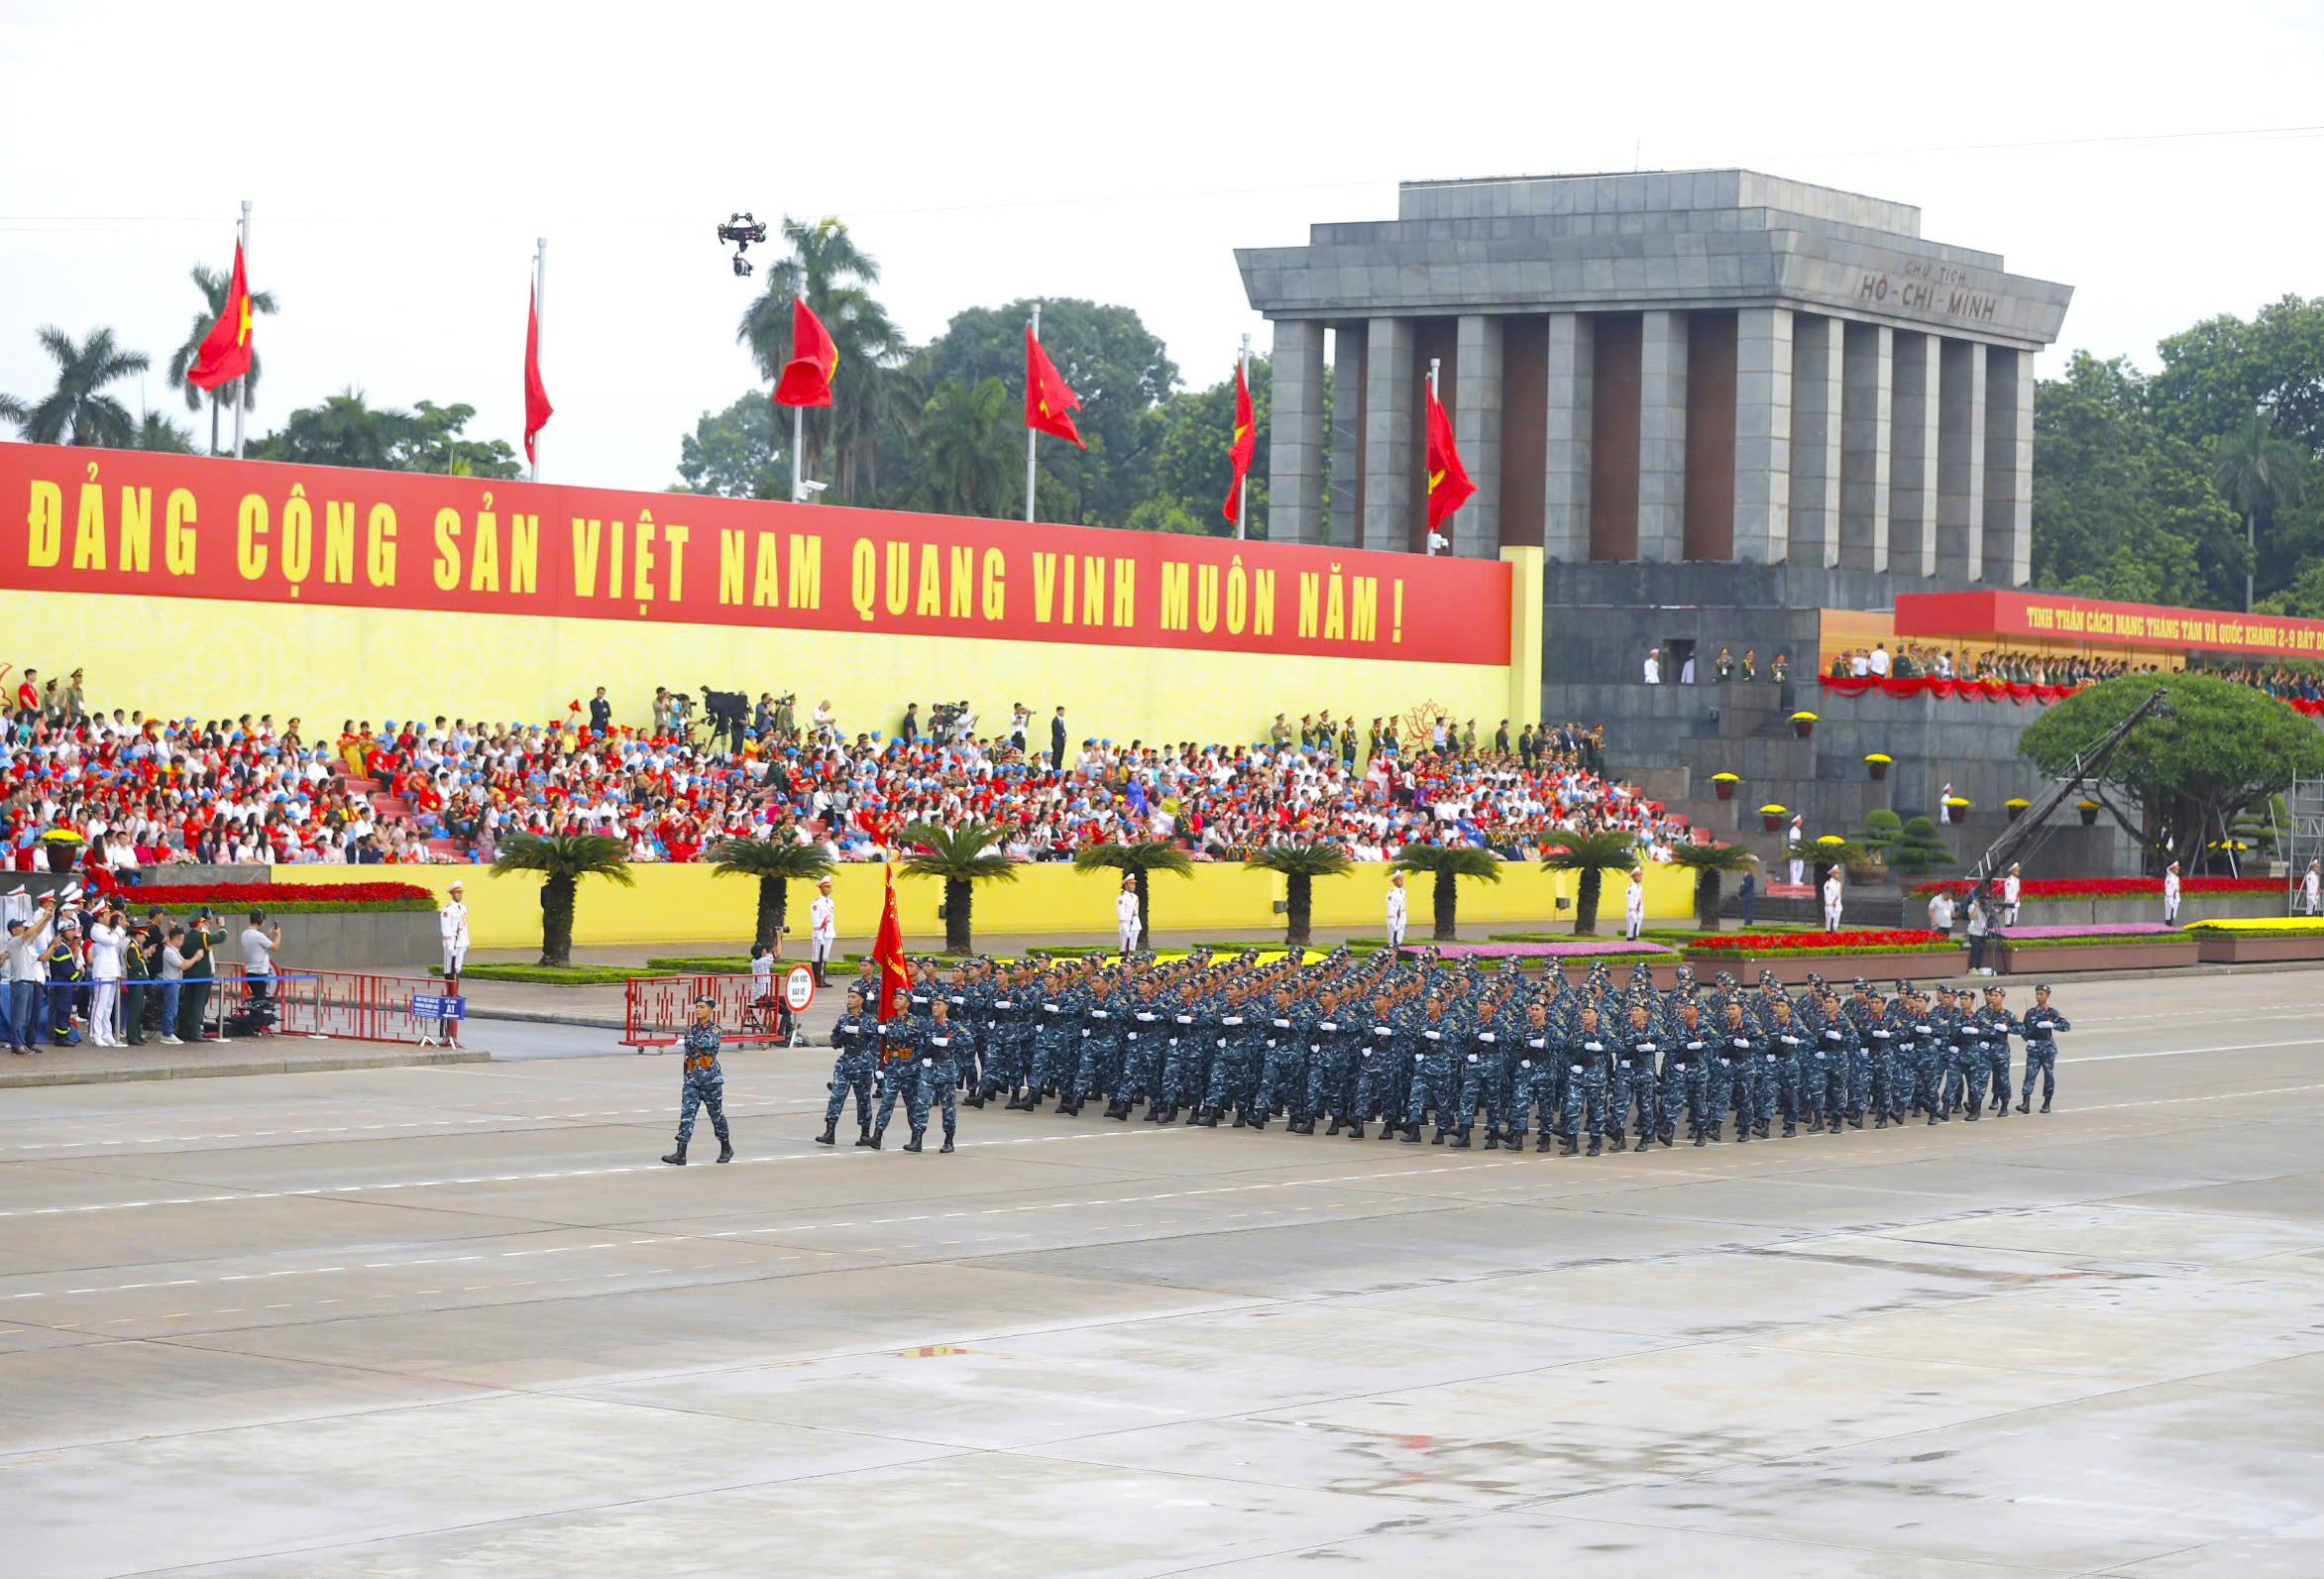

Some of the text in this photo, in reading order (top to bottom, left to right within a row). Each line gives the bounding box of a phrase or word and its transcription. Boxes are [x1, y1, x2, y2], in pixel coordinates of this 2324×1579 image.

[28, 462, 197, 576] ĐẢNG
[237, 483, 396, 597] CỘNG
[434, 492, 538, 594] SẢN
[572, 509, 689, 616] VIỆT
[720, 529, 821, 610] NAM
[852, 538, 1005, 621] QUANG
[1033, 552, 1136, 627] VINH
[1161, 554, 1275, 636] MUÔN
[2027, 607, 2053, 628] TINH
[2086, 609, 2114, 633] CÁCH
[2116, 615, 2144, 639] MẠNG
[2146, 615, 2179, 639] THÁNG
[2245, 623, 2276, 646] KHÁNH
